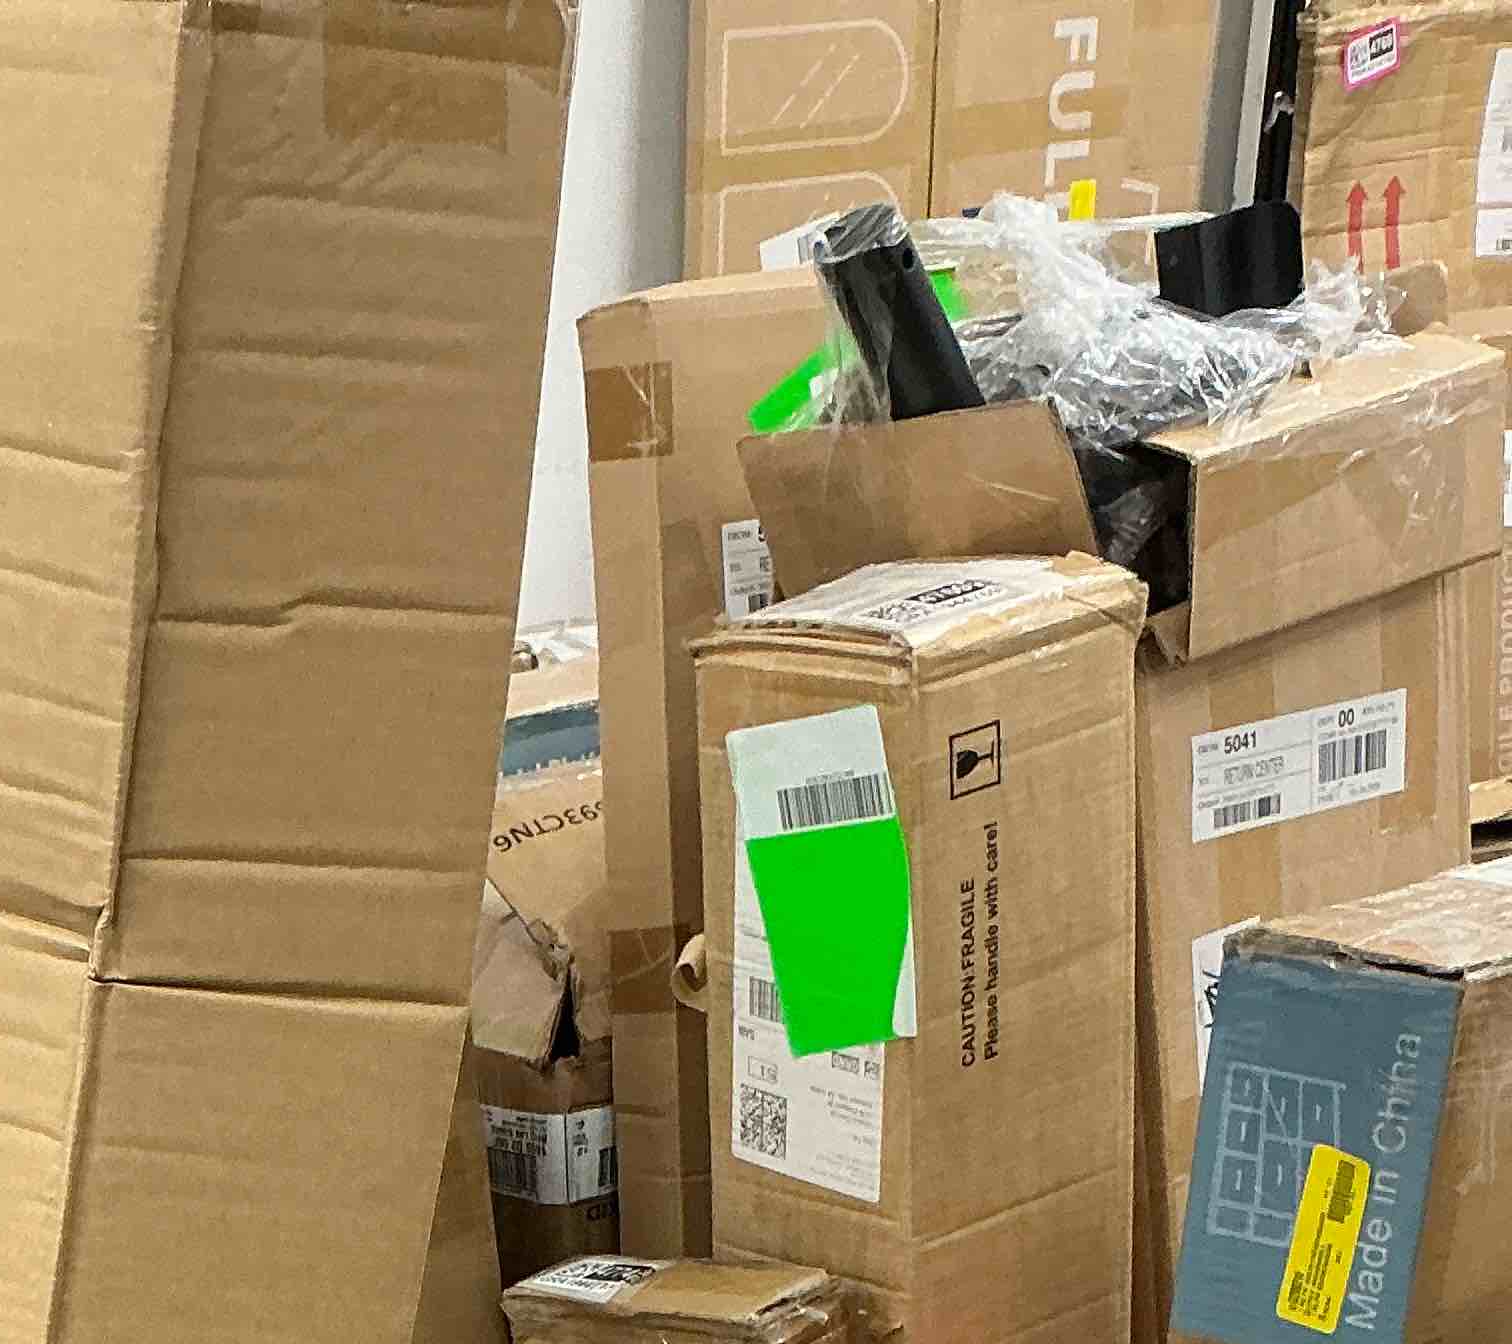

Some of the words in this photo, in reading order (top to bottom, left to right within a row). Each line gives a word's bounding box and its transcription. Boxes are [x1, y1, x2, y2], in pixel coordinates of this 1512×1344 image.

[1223, 731, 1258, 755] 5041
[1337, 708, 1355, 728] 00
[984, 876, 999, 921] with
[984, 924, 999, 991] handle
[984, 993, 999, 1060] Please
[1345, 1216, 1393, 1330] Made
[1370, 1032, 1423, 1154] China
